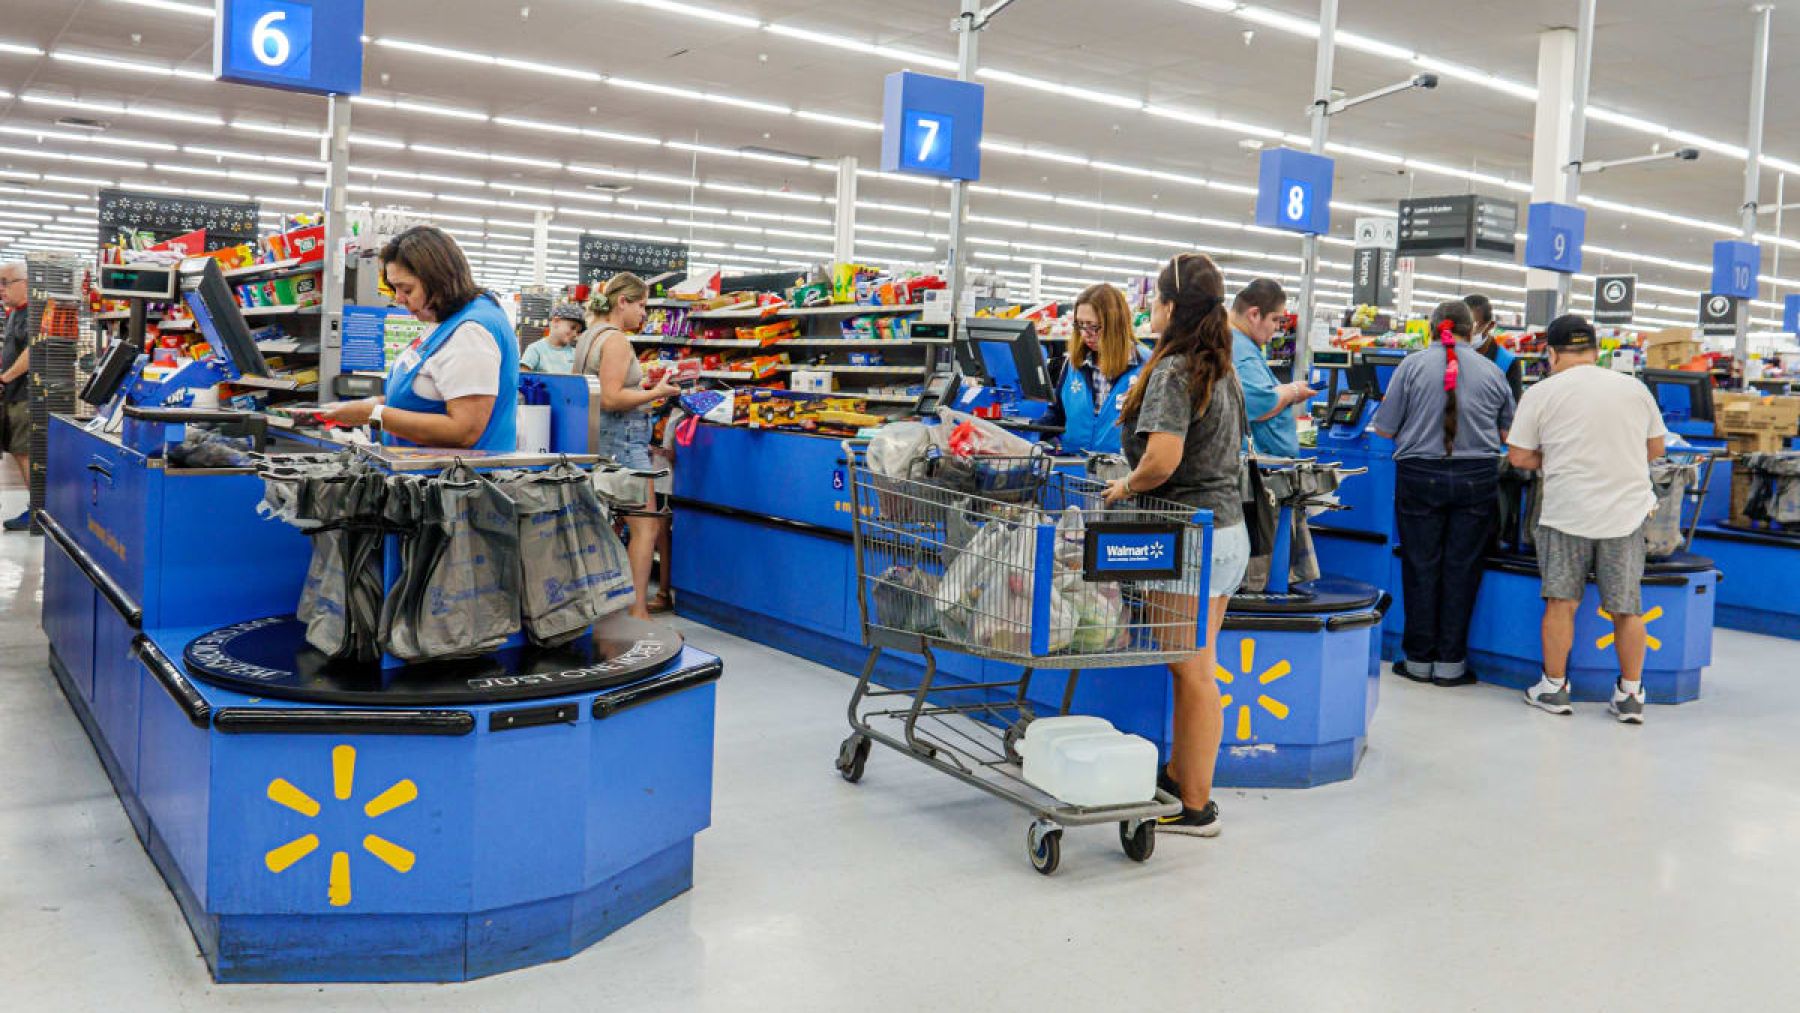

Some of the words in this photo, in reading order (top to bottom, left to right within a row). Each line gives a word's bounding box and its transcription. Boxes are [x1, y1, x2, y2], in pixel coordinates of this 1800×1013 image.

[251, 11, 290, 67] 6
[918, 119, 940, 162] 7
[1287, 185, 1304, 220] 8
[1554, 233, 1566, 261] 9
[1359, 251, 1371, 286] Home
[1382, 252, 1392, 286] Home
[1734, 266, 1750, 291] 10
[1106, 545, 1149, 556] Walmart
[467, 673, 553, 688] JUST
